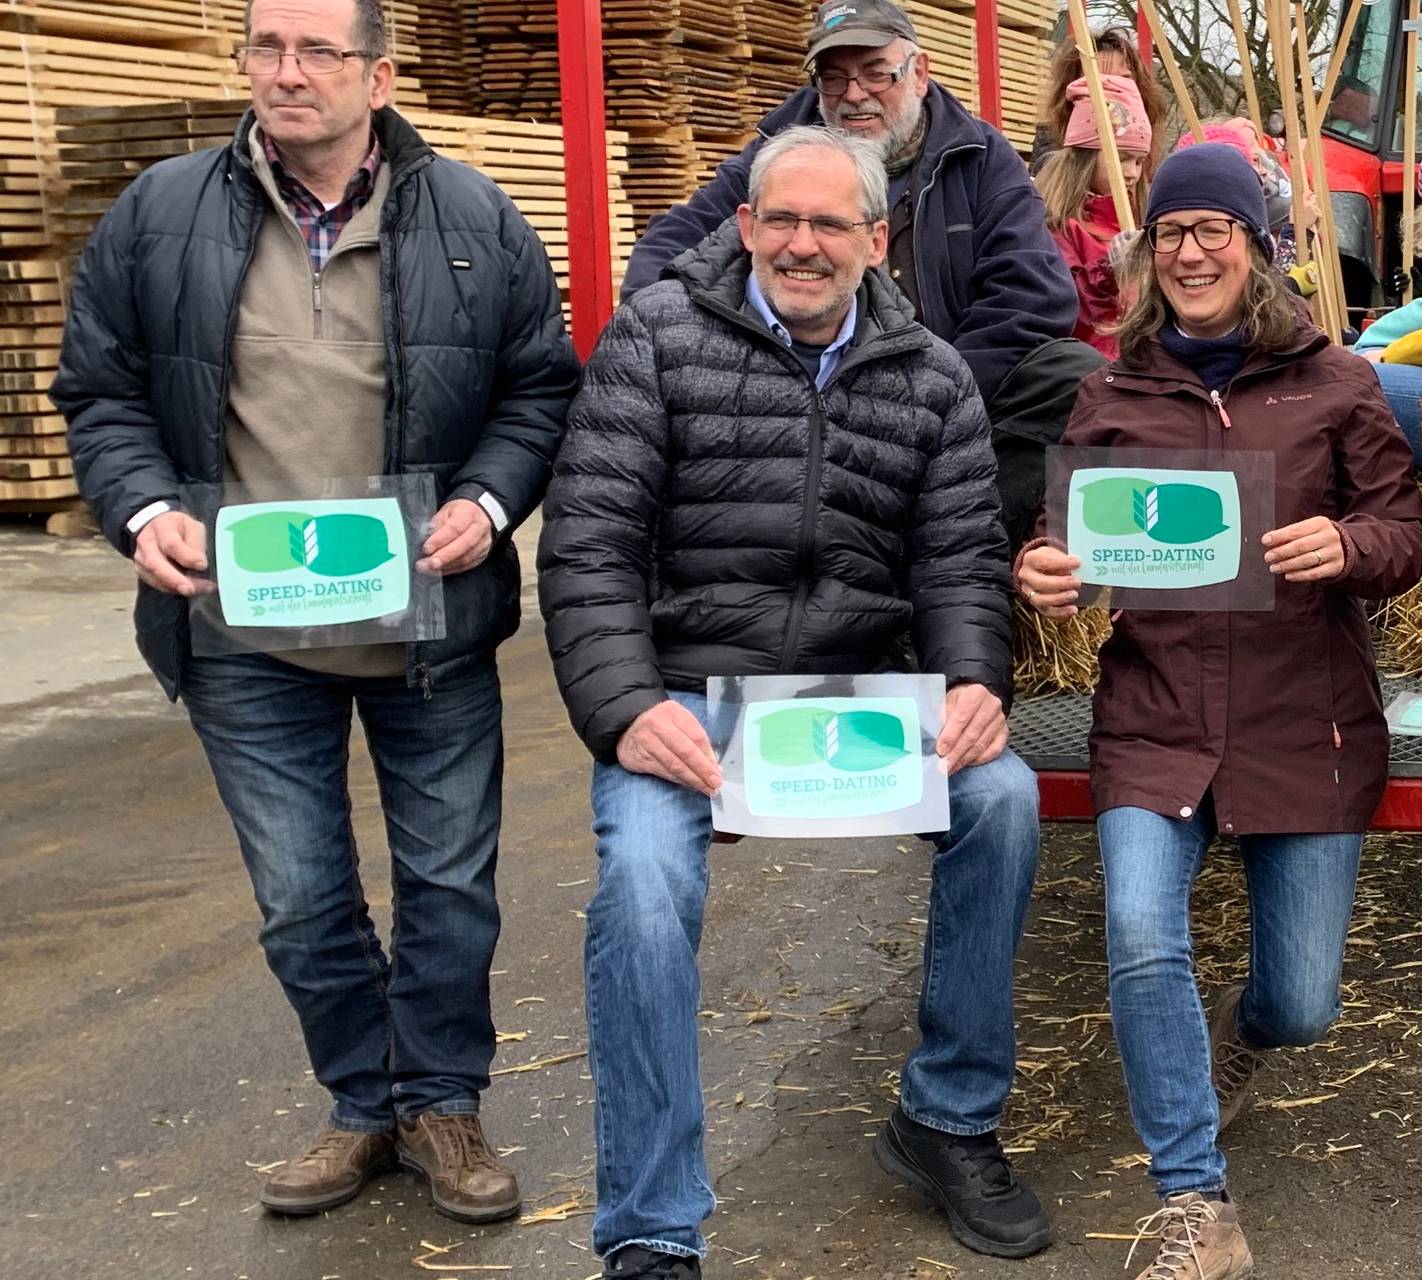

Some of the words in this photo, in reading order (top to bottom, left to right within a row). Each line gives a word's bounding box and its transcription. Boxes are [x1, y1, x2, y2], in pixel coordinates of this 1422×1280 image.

[1092, 548, 1215, 562] SPEED-DATING
[248, 578, 382, 601] SPEED-DATING
[770, 774, 898, 794] SPEED-DATING
